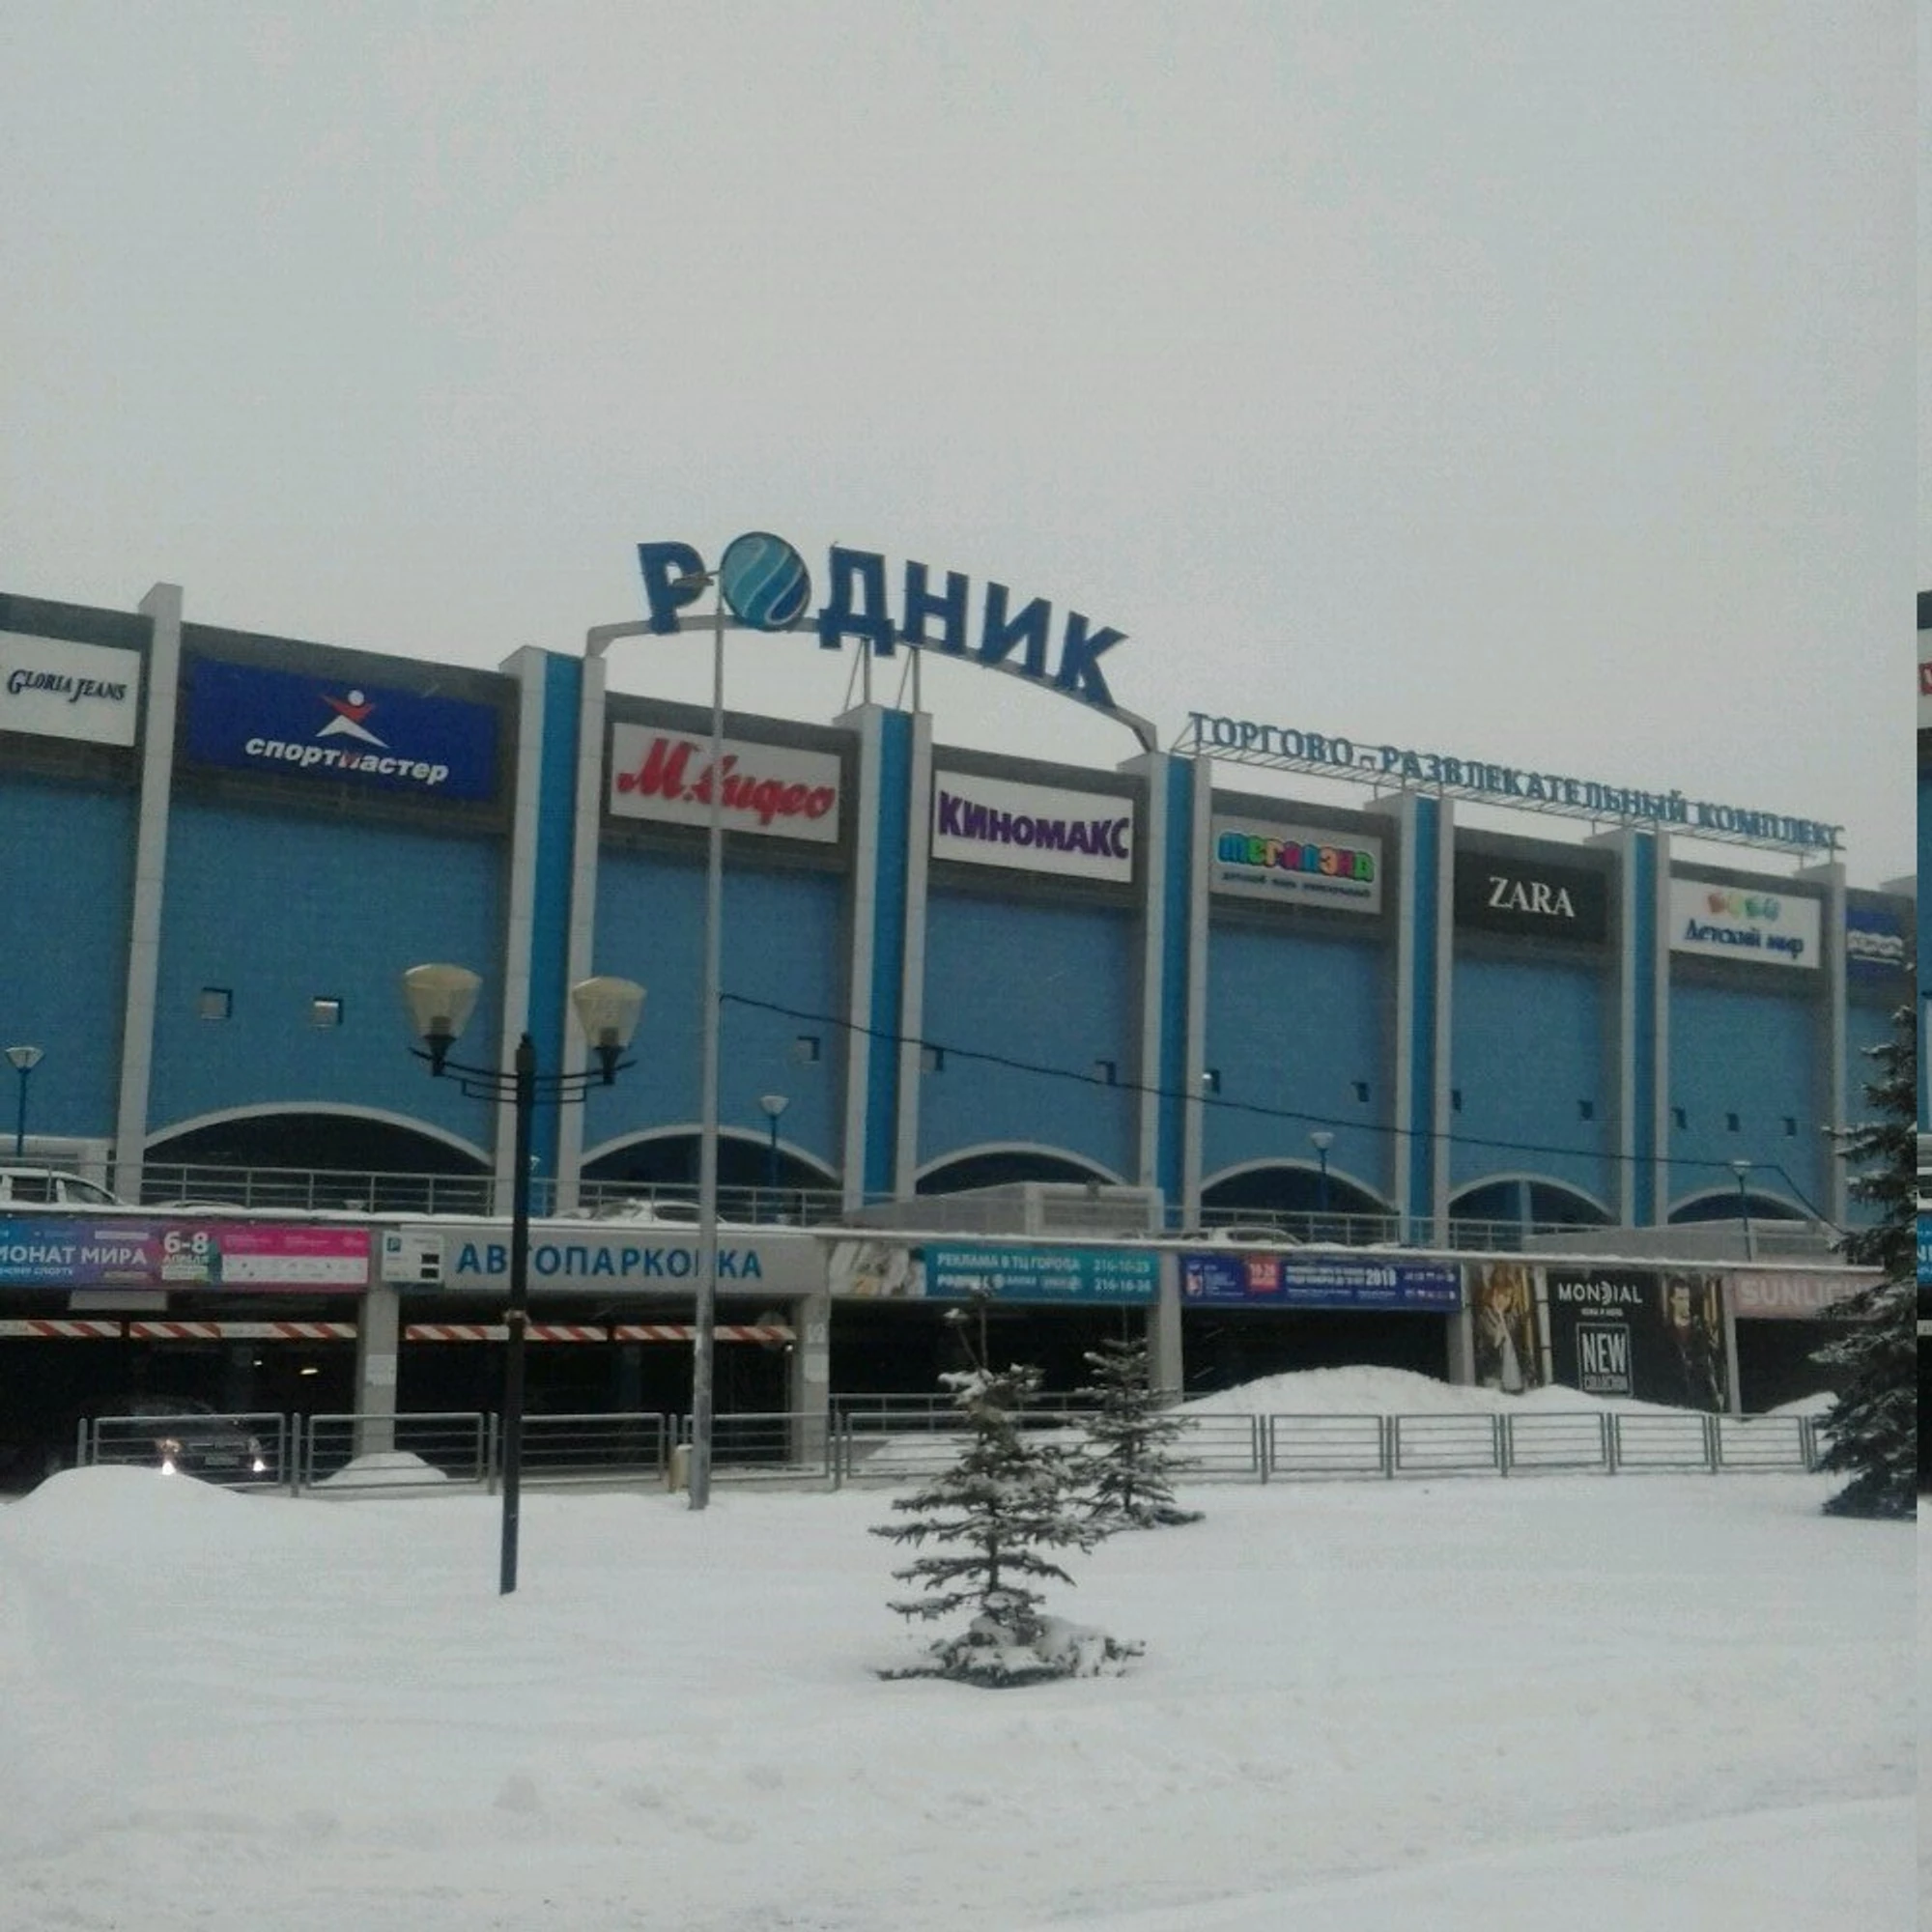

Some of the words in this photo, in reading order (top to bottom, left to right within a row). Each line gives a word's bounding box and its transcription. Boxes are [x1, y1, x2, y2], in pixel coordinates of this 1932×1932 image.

[638, 531, 1128, 708] РОДНИК
[1489, 876, 1576, 918] ZARA
[82, 1246, 147, 1265] МИРА
[163, 1231, 209, 1254] 6-8
[456, 1243, 762, 1279] АВОПАРКОКА
[1558, 1281, 1643, 1306] MONDIAL
[1582, 1332, 1626, 1374] NEW
